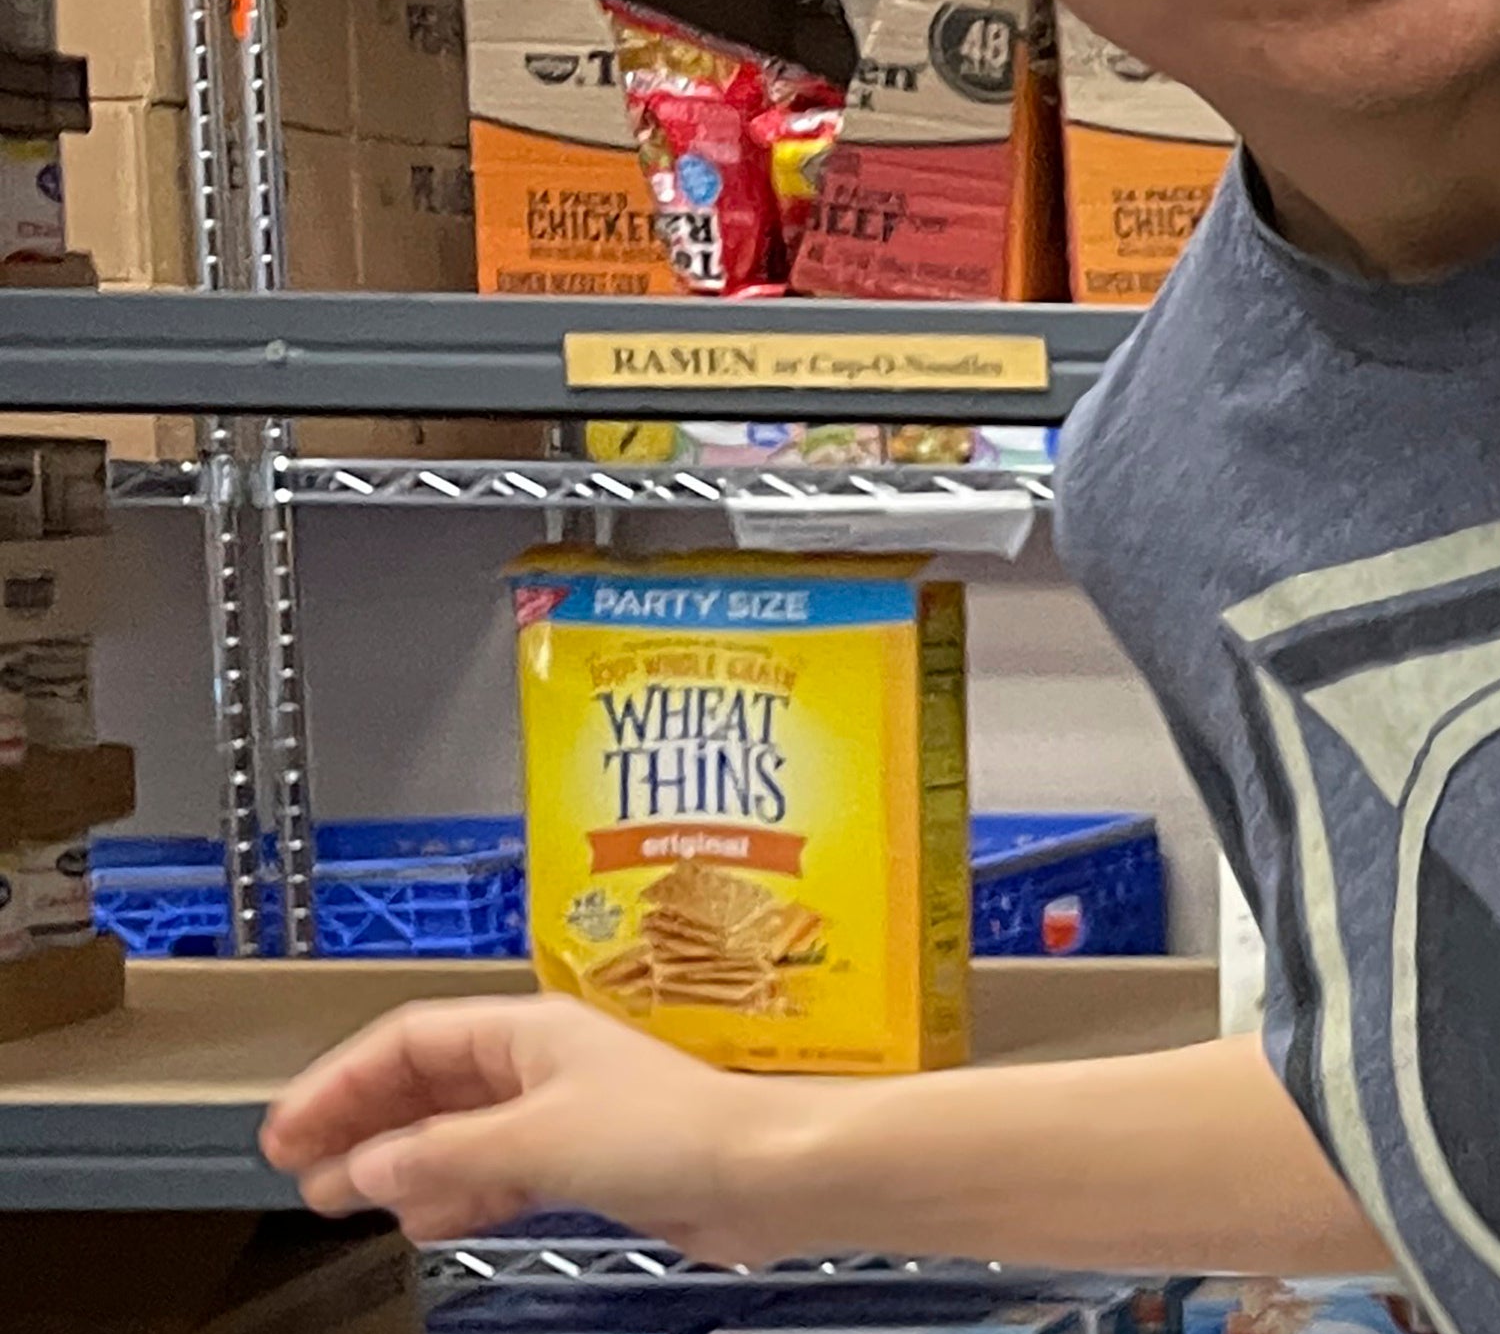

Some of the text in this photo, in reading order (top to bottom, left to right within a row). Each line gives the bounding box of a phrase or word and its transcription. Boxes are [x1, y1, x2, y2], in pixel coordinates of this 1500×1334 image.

[612, 347, 757, 378] RAMEN
[594, 588, 810, 620] PARTY SIZE
[597, 683, 790, 749] WHEAT
[641, 832, 750, 860] original
